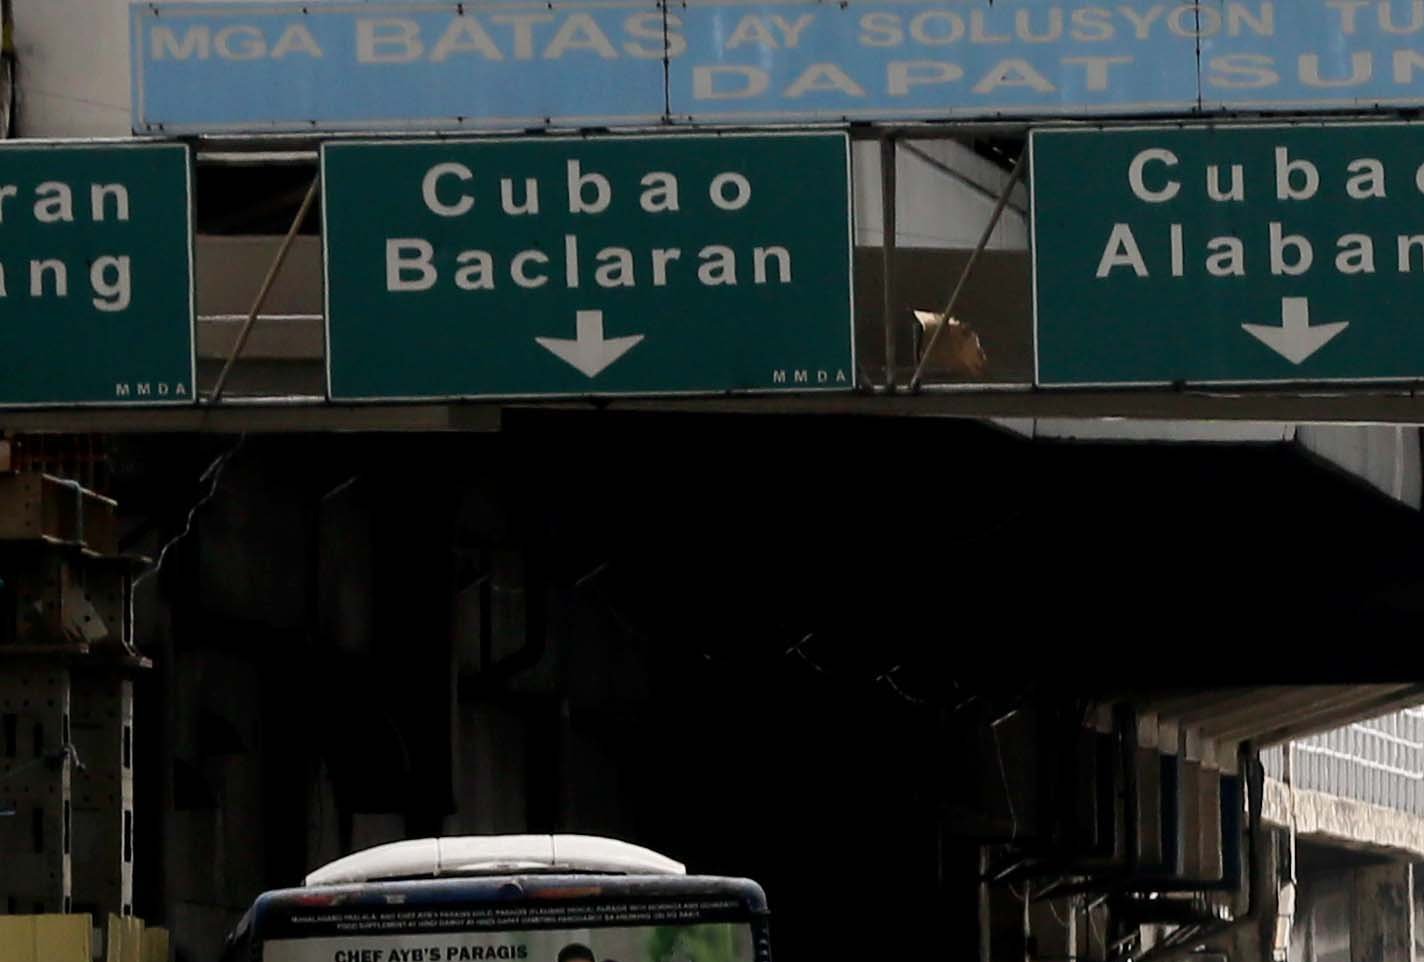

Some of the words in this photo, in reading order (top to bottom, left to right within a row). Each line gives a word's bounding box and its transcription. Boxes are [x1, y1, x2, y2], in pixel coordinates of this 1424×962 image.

[150, 25, 322, 61] MGA
[354, 13, 687, 64] BATAS
[726, 13, 816, 50] AY
[858, 1, 1276, 49] SOLUSYON
[692, 56, 1132, 100] DAPAT
[422, 160, 752, 216] Cubao
[0, 255, 132, 313] ng
[386, 234, 793, 291] Baclaran
[116, 382, 187, 396] MMDA
[774, 370, 846, 383] MMDA
[447, 944, 529, 961] PARAGIS
